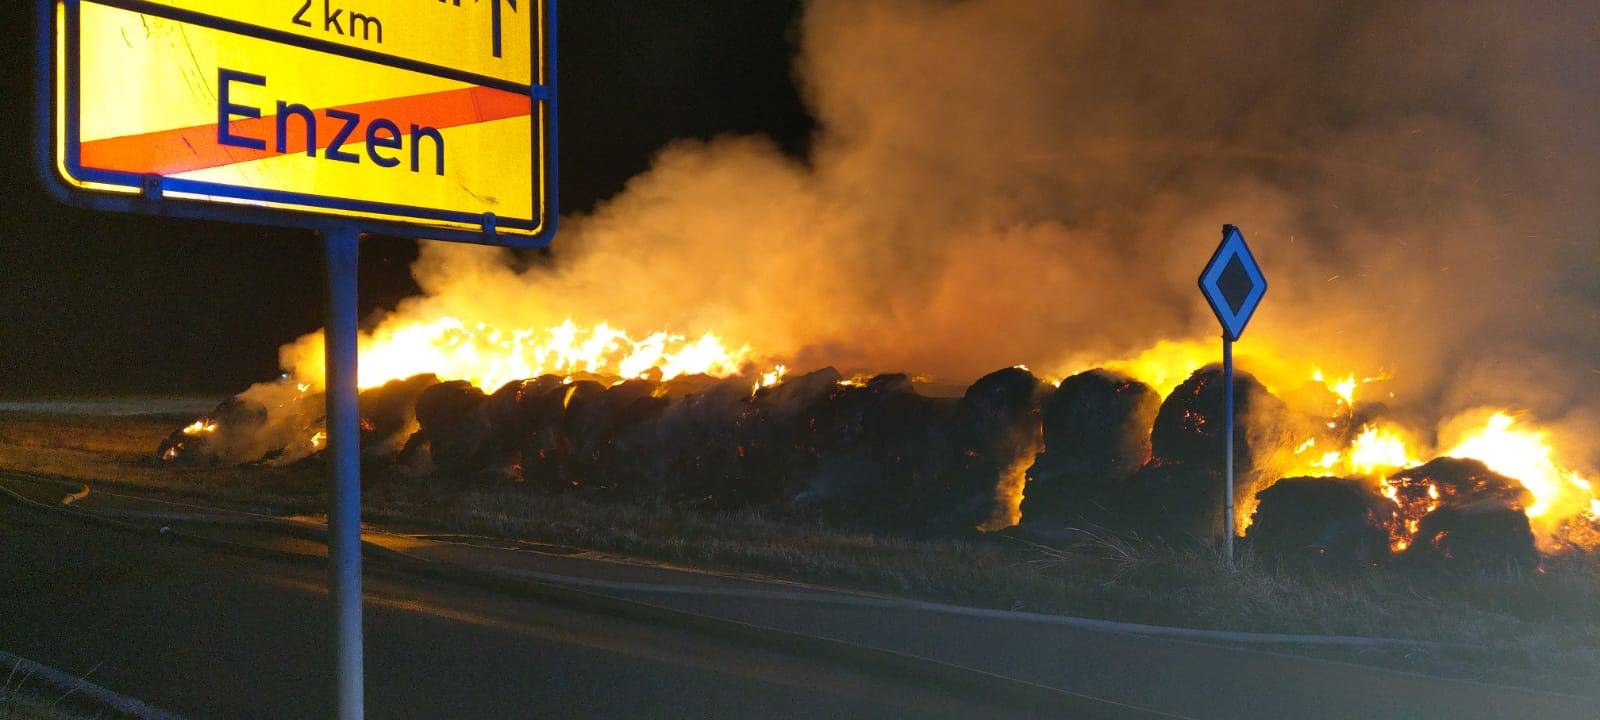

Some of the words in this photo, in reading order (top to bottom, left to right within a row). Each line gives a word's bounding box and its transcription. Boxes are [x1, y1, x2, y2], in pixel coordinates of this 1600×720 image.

[292, 0, 312, 27] 2
[324, 0, 382, 43] km
[217, 67, 445, 176] Enzen
